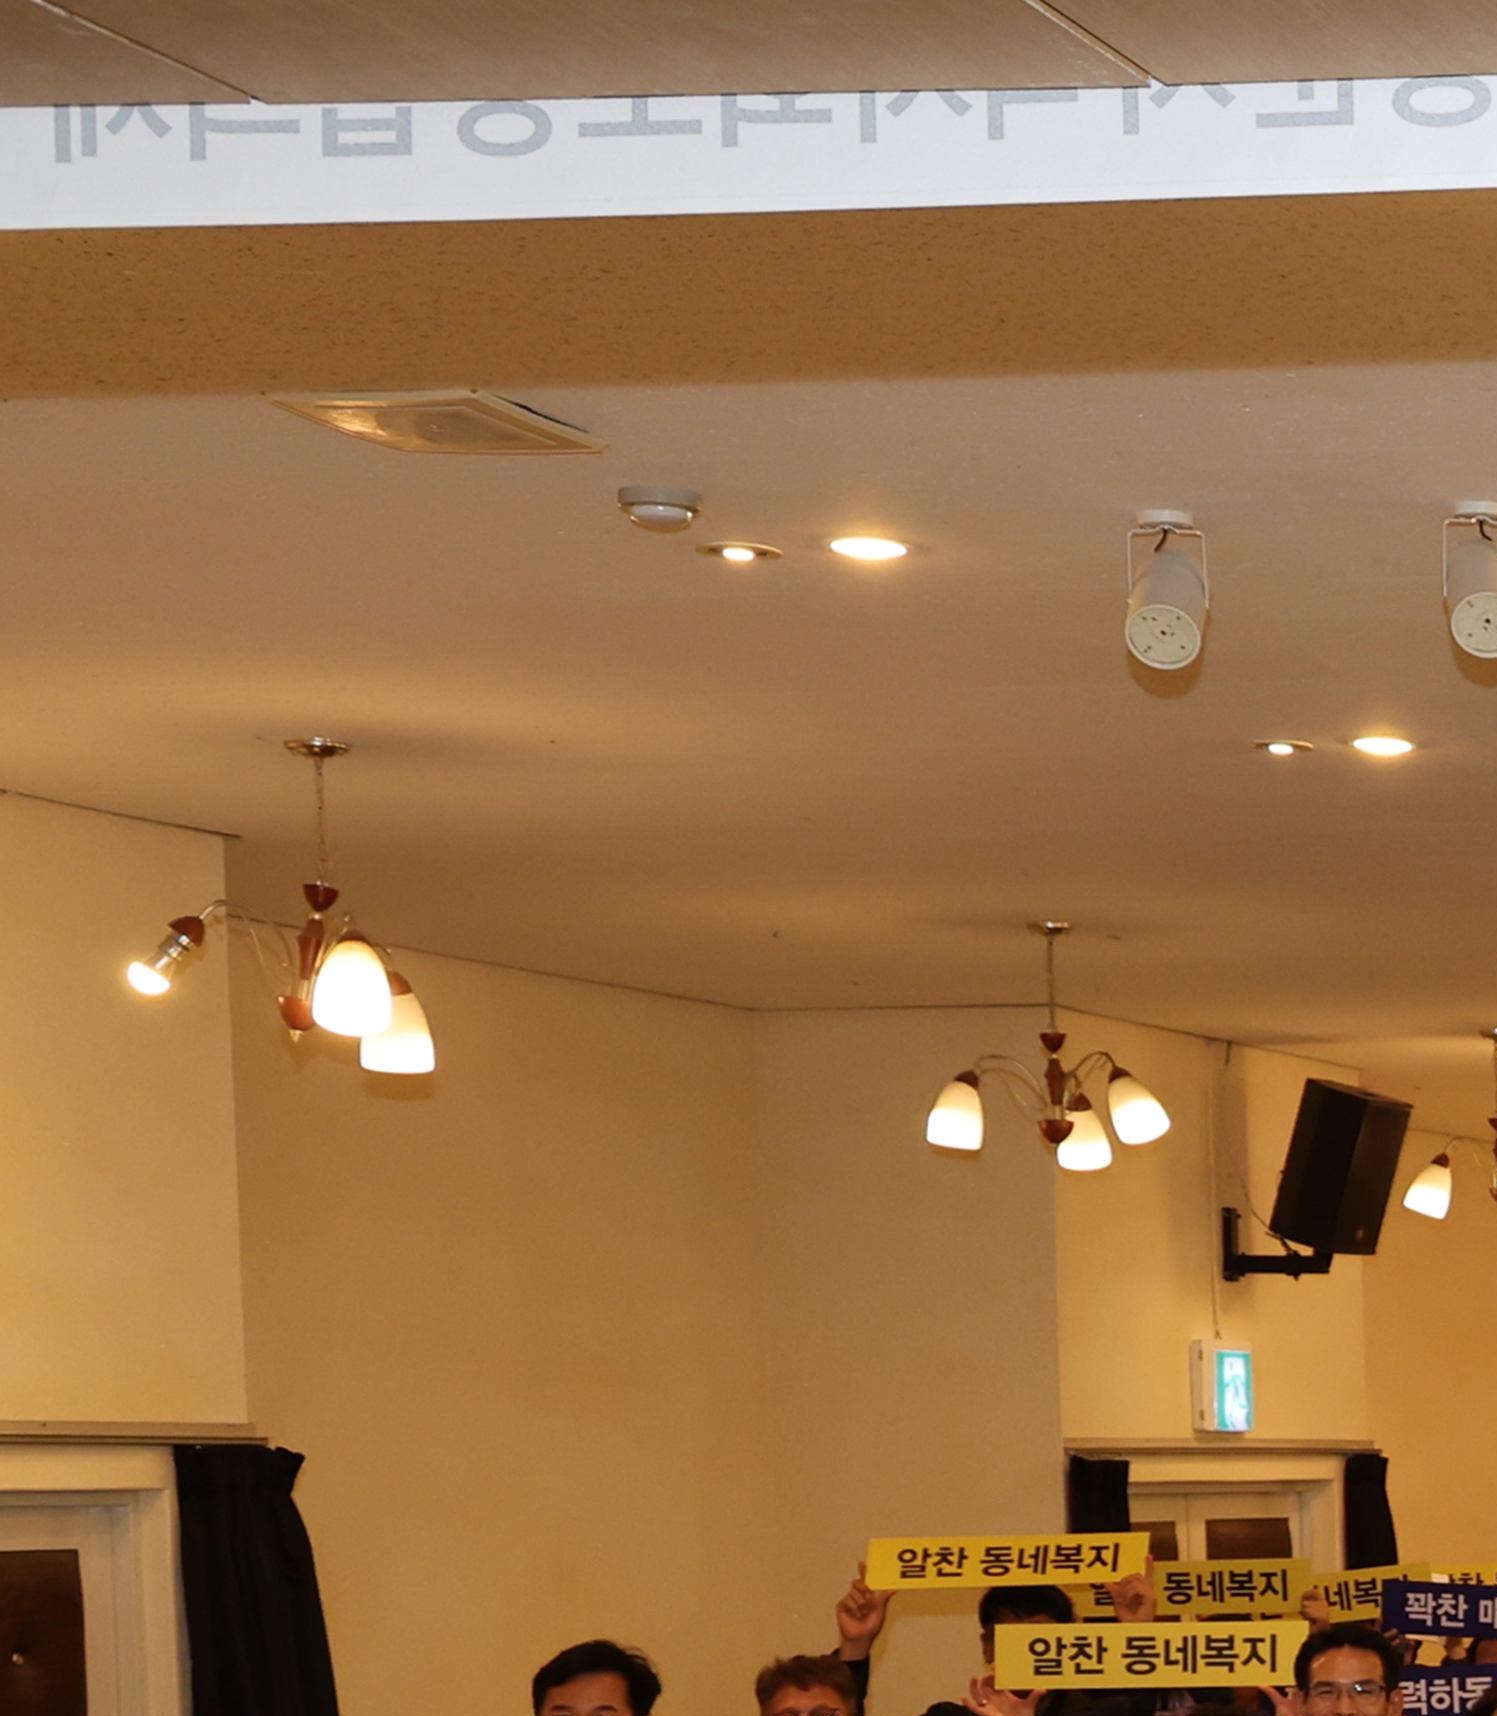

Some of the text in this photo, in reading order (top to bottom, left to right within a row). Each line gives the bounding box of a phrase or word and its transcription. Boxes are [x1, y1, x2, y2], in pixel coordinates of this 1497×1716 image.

[897, 1543, 1120, 1578] 알찬 동네복지
[1163, 1569, 1288, 1605] 동네복지
[1404, 1591, 1468, 1627] 꽉찬
[1028, 1634, 1278, 1676] 알찬 동네복지
